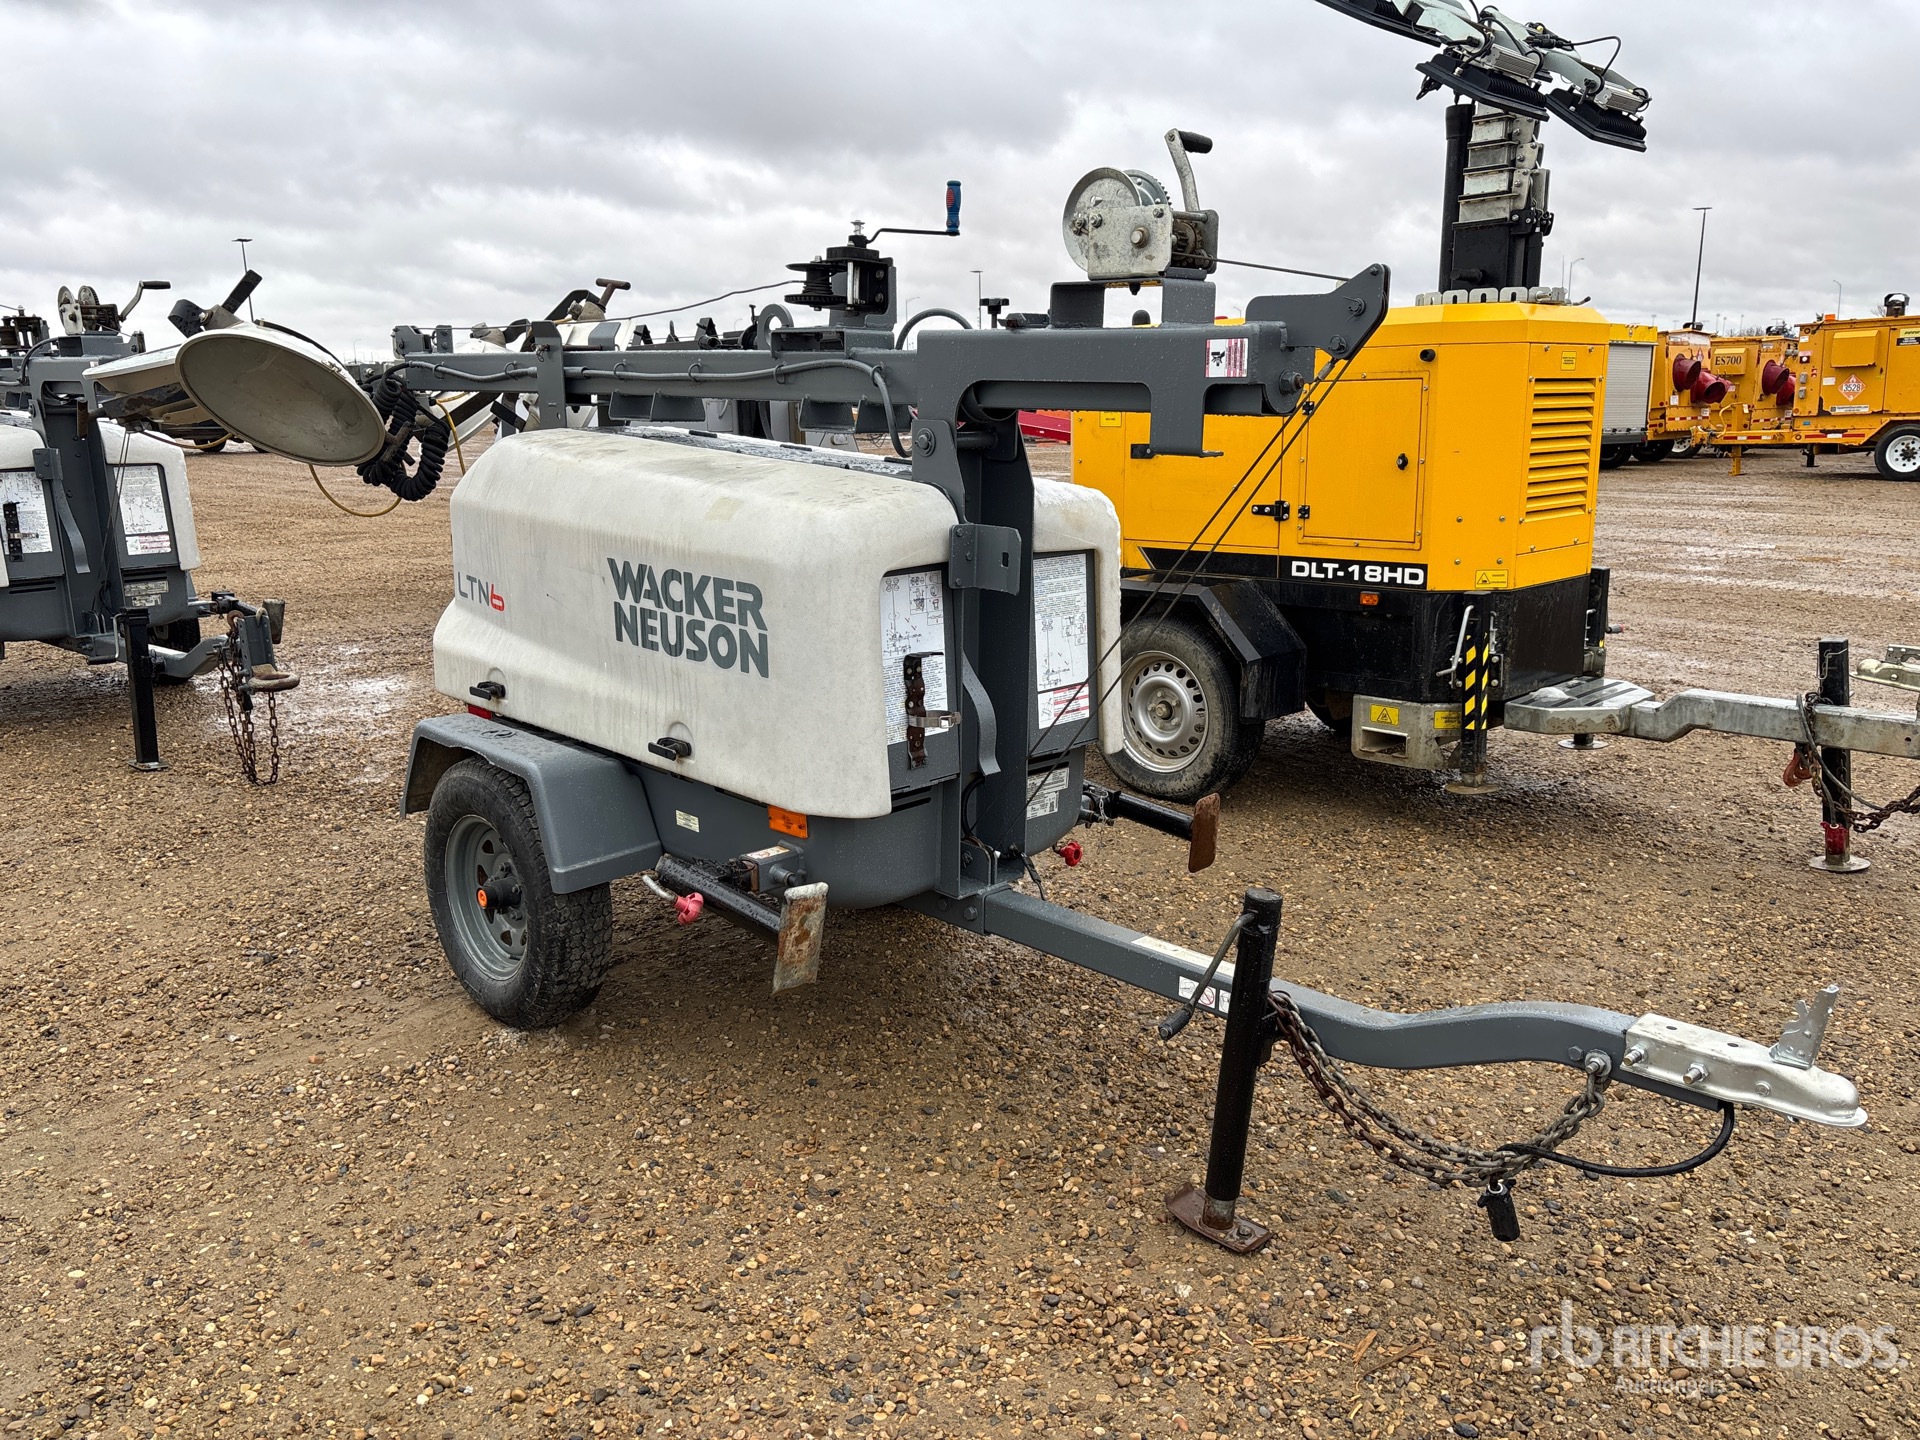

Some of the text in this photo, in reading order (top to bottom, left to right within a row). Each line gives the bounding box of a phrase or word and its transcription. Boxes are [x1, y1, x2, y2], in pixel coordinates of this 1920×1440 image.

[1714, 355, 1742, 366] ES700
[1843, 383, 1861, 392] 3528
[1291, 560, 1424, 586] DLT-18HD
[457, 571, 505, 612] LTN6
[607, 557, 768, 631] WACKER
[613, 601, 769, 679] NEUSON
